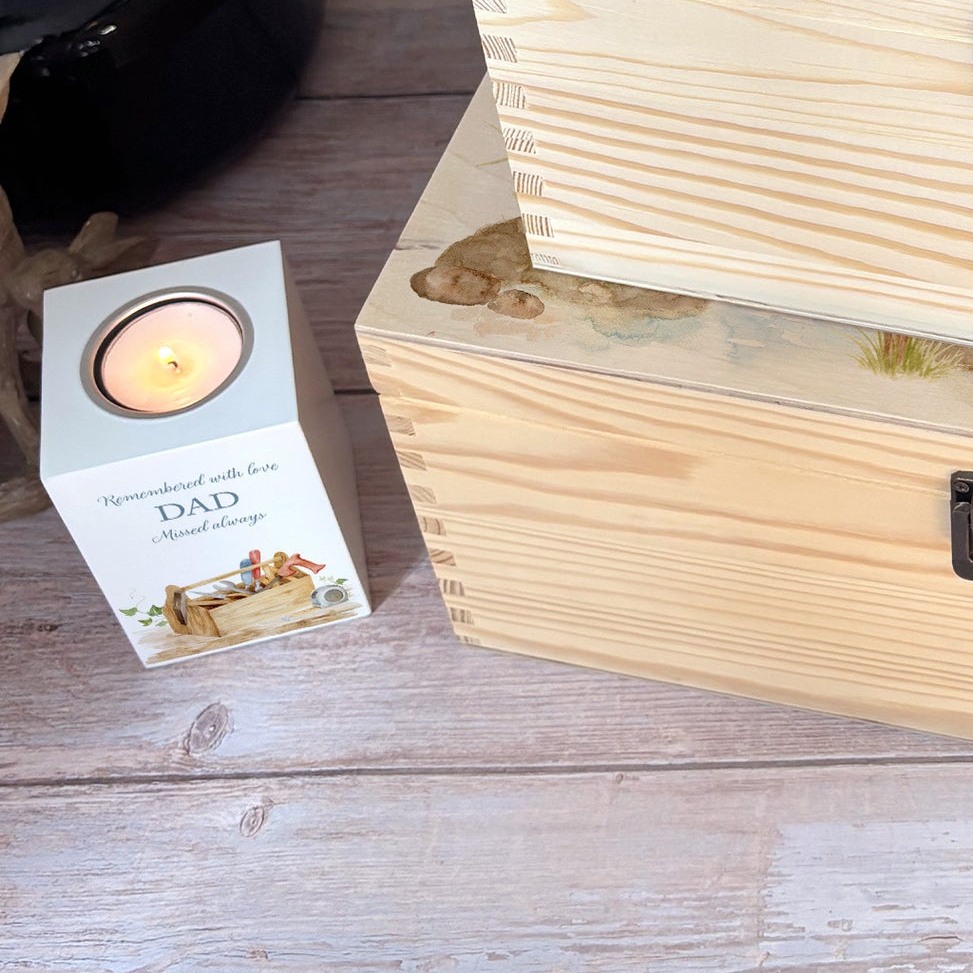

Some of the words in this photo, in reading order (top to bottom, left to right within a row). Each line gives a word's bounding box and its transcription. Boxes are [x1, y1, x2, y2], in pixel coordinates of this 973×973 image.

[96, 474, 206, 508] Remembered
[208, 466, 244, 484] with
[247, 461, 279, 477] love
[154, 490, 240, 522] DAD
[151, 518, 209, 544] Missed
[212, 510, 267, 530] always
